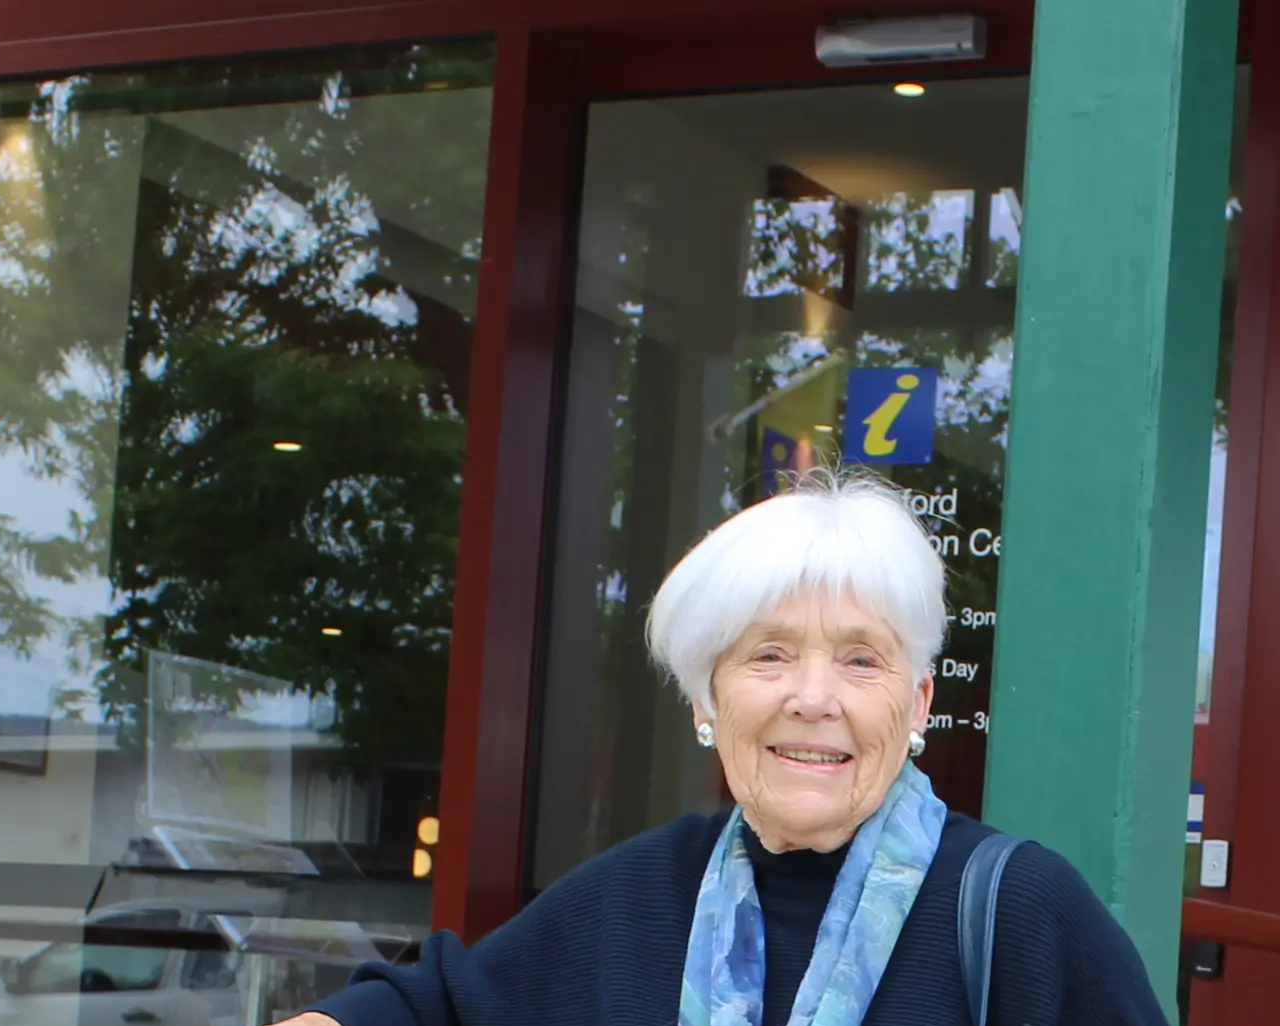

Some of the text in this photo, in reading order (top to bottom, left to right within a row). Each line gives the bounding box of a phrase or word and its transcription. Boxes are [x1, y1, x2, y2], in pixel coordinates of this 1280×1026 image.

[902, 488, 958, 515] ford
[927, 528, 1002, 556] on Ce
[942, 658, 979, 682] Day
